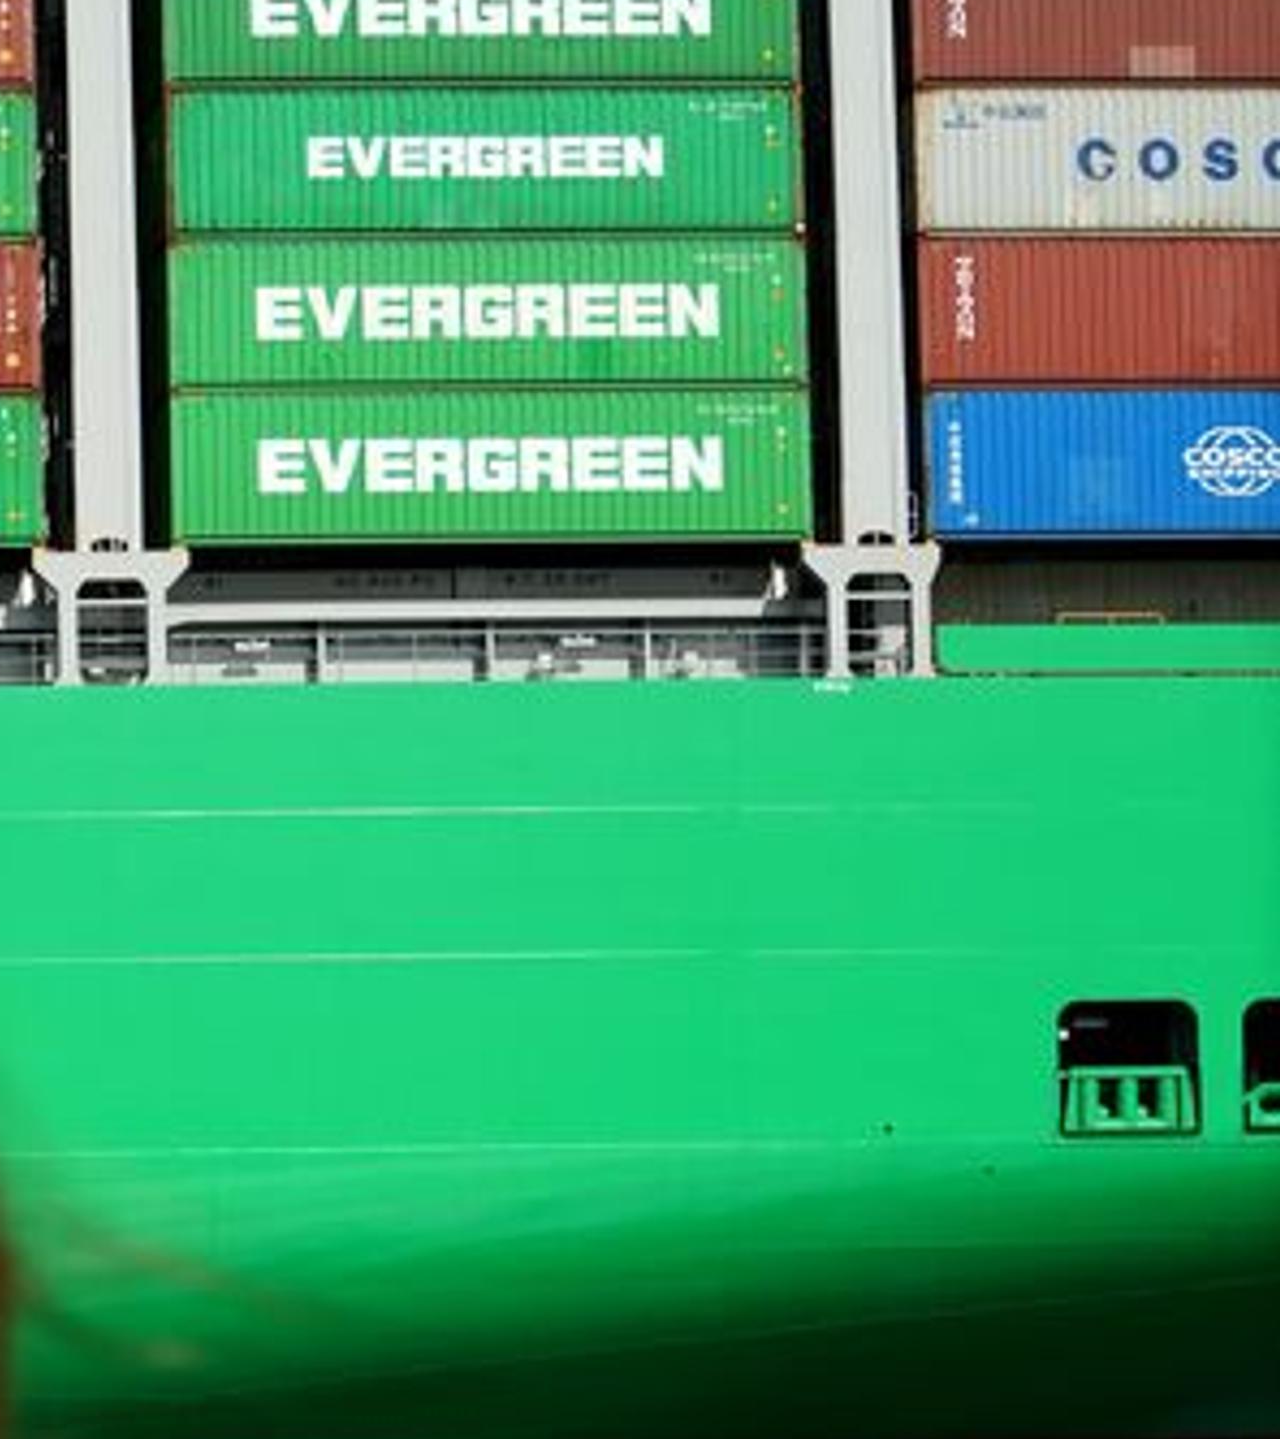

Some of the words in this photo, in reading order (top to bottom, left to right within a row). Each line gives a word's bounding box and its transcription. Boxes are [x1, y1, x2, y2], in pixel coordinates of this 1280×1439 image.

[307, 136, 663, 178] EVERGREEN
[255, 283, 719, 340] EVERGREEN
[258, 437, 723, 493] EVERGREEN
